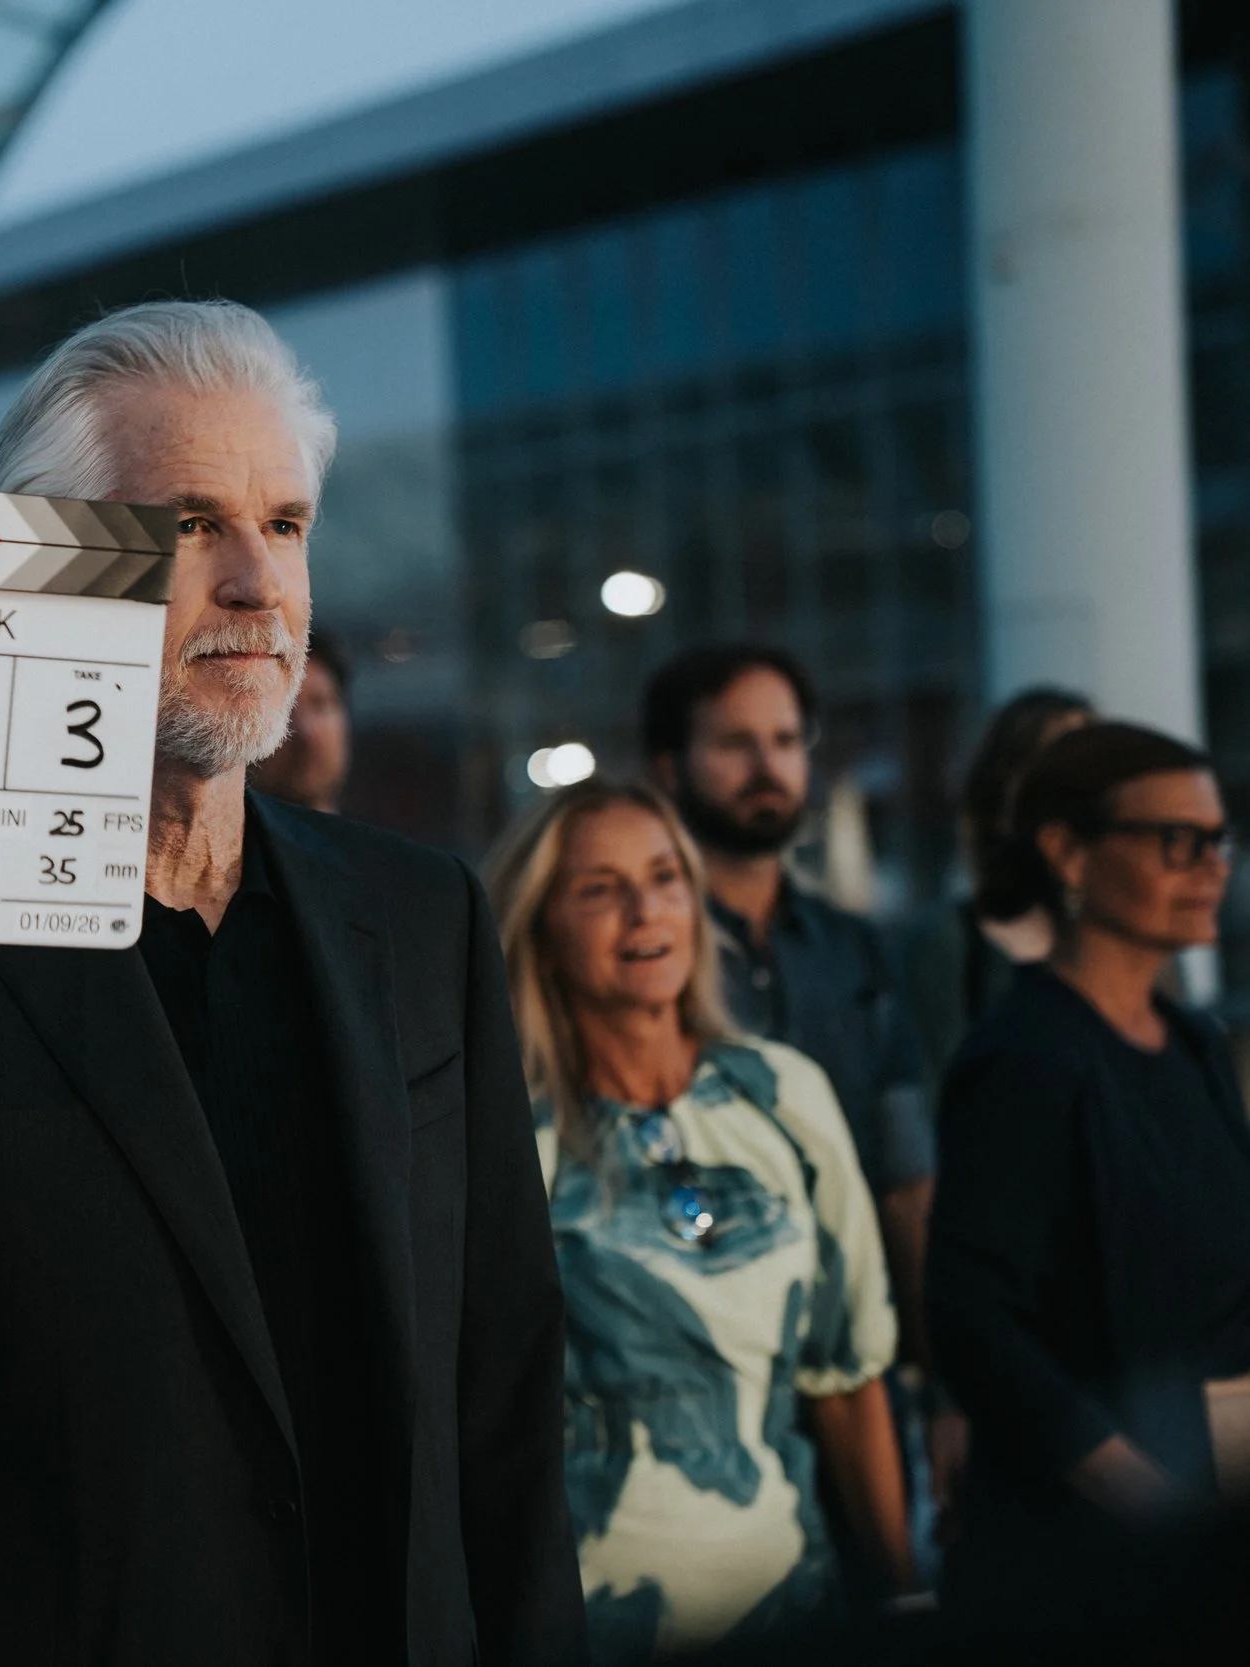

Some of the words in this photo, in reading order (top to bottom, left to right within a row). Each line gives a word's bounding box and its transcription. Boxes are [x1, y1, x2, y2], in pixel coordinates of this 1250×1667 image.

[73, 669, 102, 682] TAKE
[60, 699, 105, 769] 3
[48, 809, 85, 837] 25
[103, 811, 144, 833] FPS
[38, 855, 77, 885] 35
[104, 863, 139, 879] mm
[19, 912, 101, 934] 01/09/26
